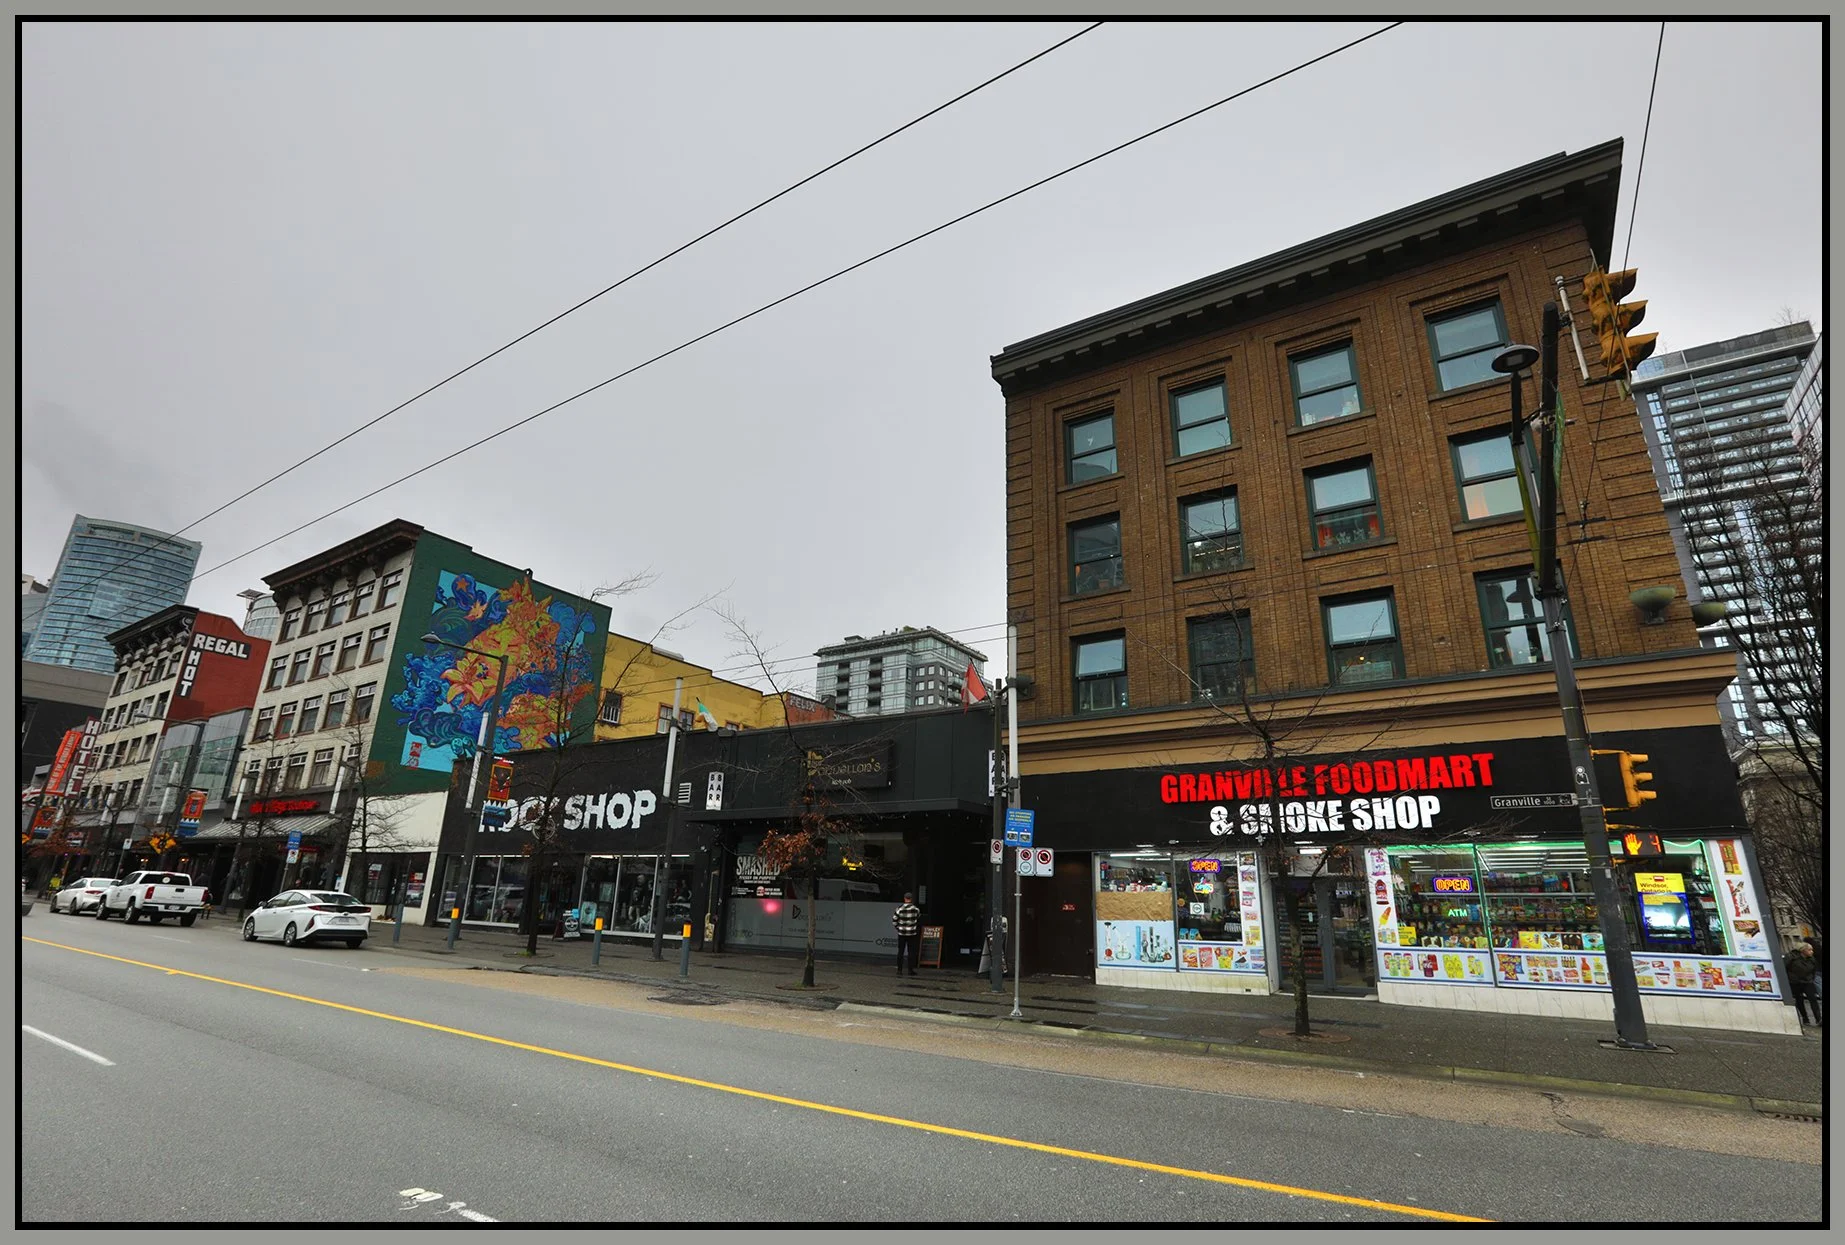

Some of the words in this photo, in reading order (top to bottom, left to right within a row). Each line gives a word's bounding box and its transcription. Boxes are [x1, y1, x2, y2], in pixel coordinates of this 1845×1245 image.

[193, 633, 247, 658] REGAL
[181, 650, 201, 696] HOT
[65, 720, 101, 796] HOTEL
[1160, 766, 1308, 804] GRANVILLE
[1315, 752, 1494, 795] FOODMART
[563, 789, 656, 830] SHOP
[1209, 805, 1234, 836] &
[1240, 799, 1345, 835] SMOKE
[1352, 795, 1441, 831] SHOP
[1494, 797, 1541, 807] Granville
[1191, 860, 1218, 872] OPEN
[1435, 878, 1470, 891] OPEN
[1448, 908, 1467, 917] ATM
